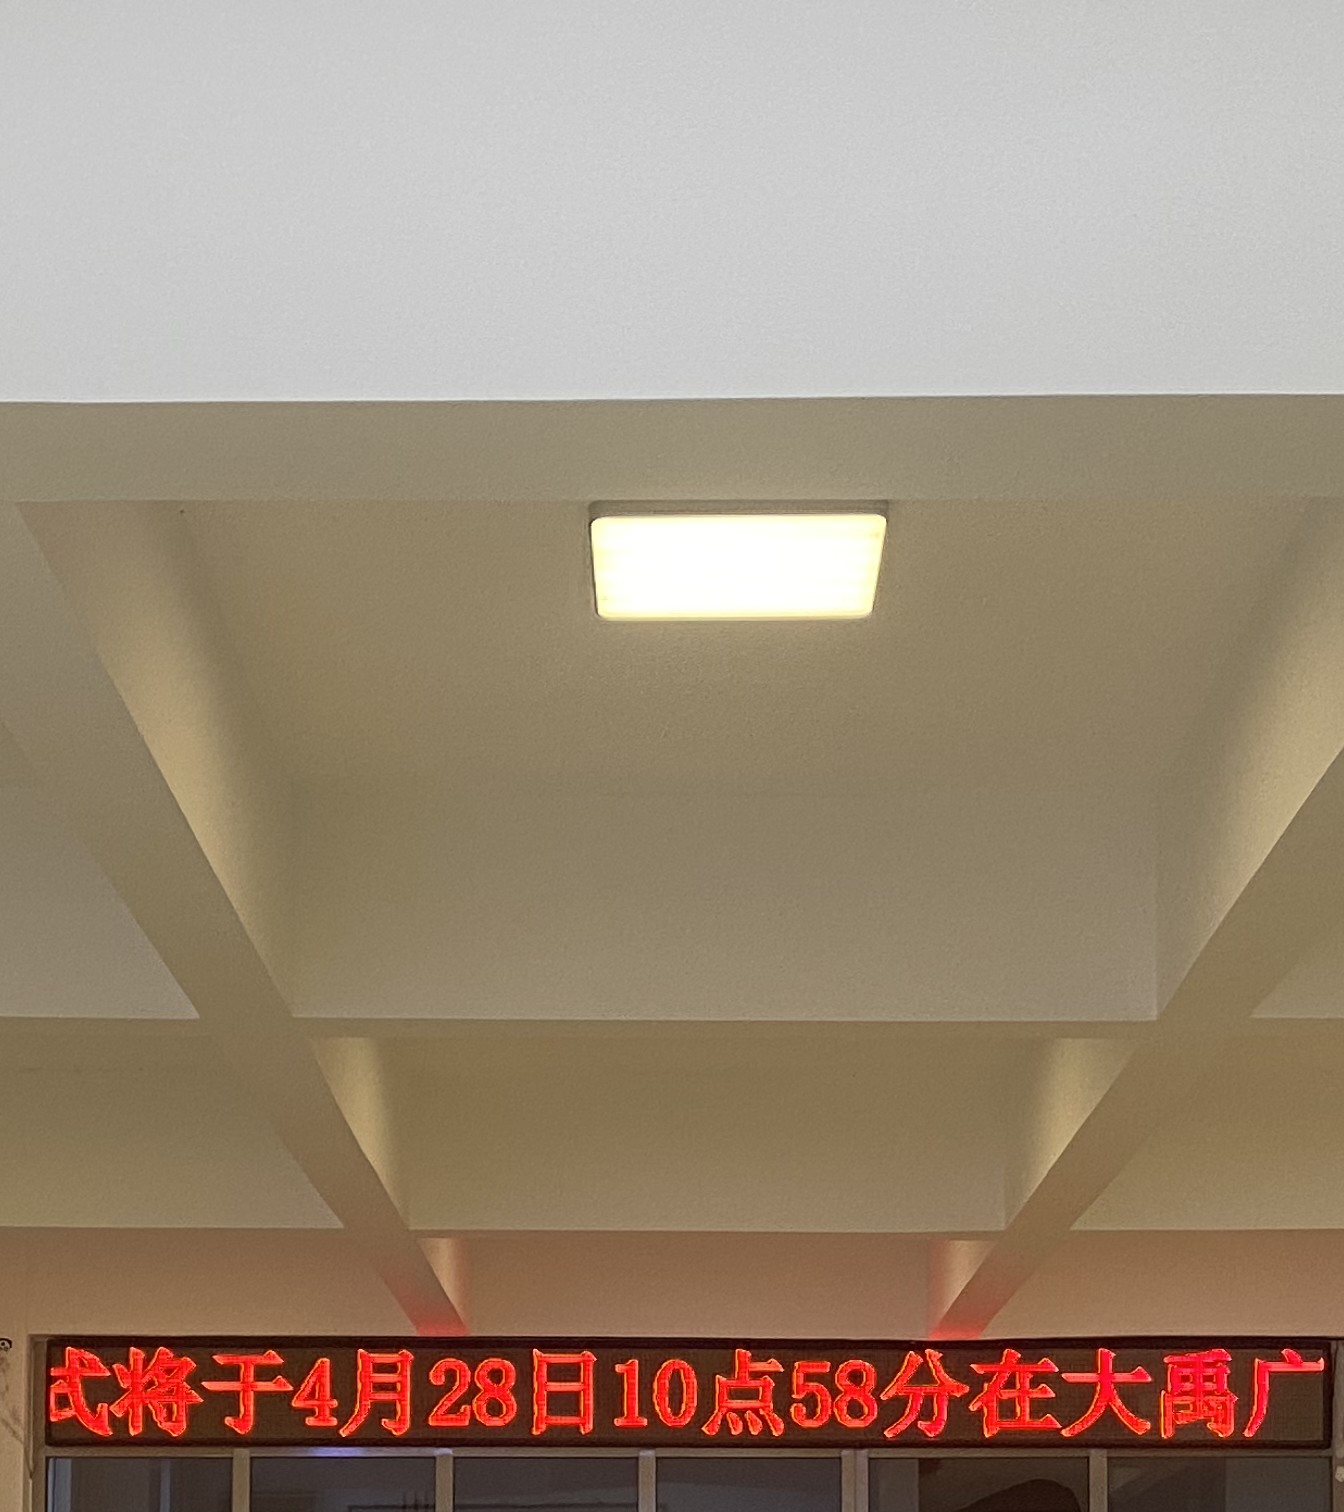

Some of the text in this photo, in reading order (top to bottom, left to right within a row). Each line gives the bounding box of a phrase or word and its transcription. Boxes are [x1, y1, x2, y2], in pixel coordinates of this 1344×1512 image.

[49, 1346, 1325, 1438] 式将于4月28日10点58分在大禹广
